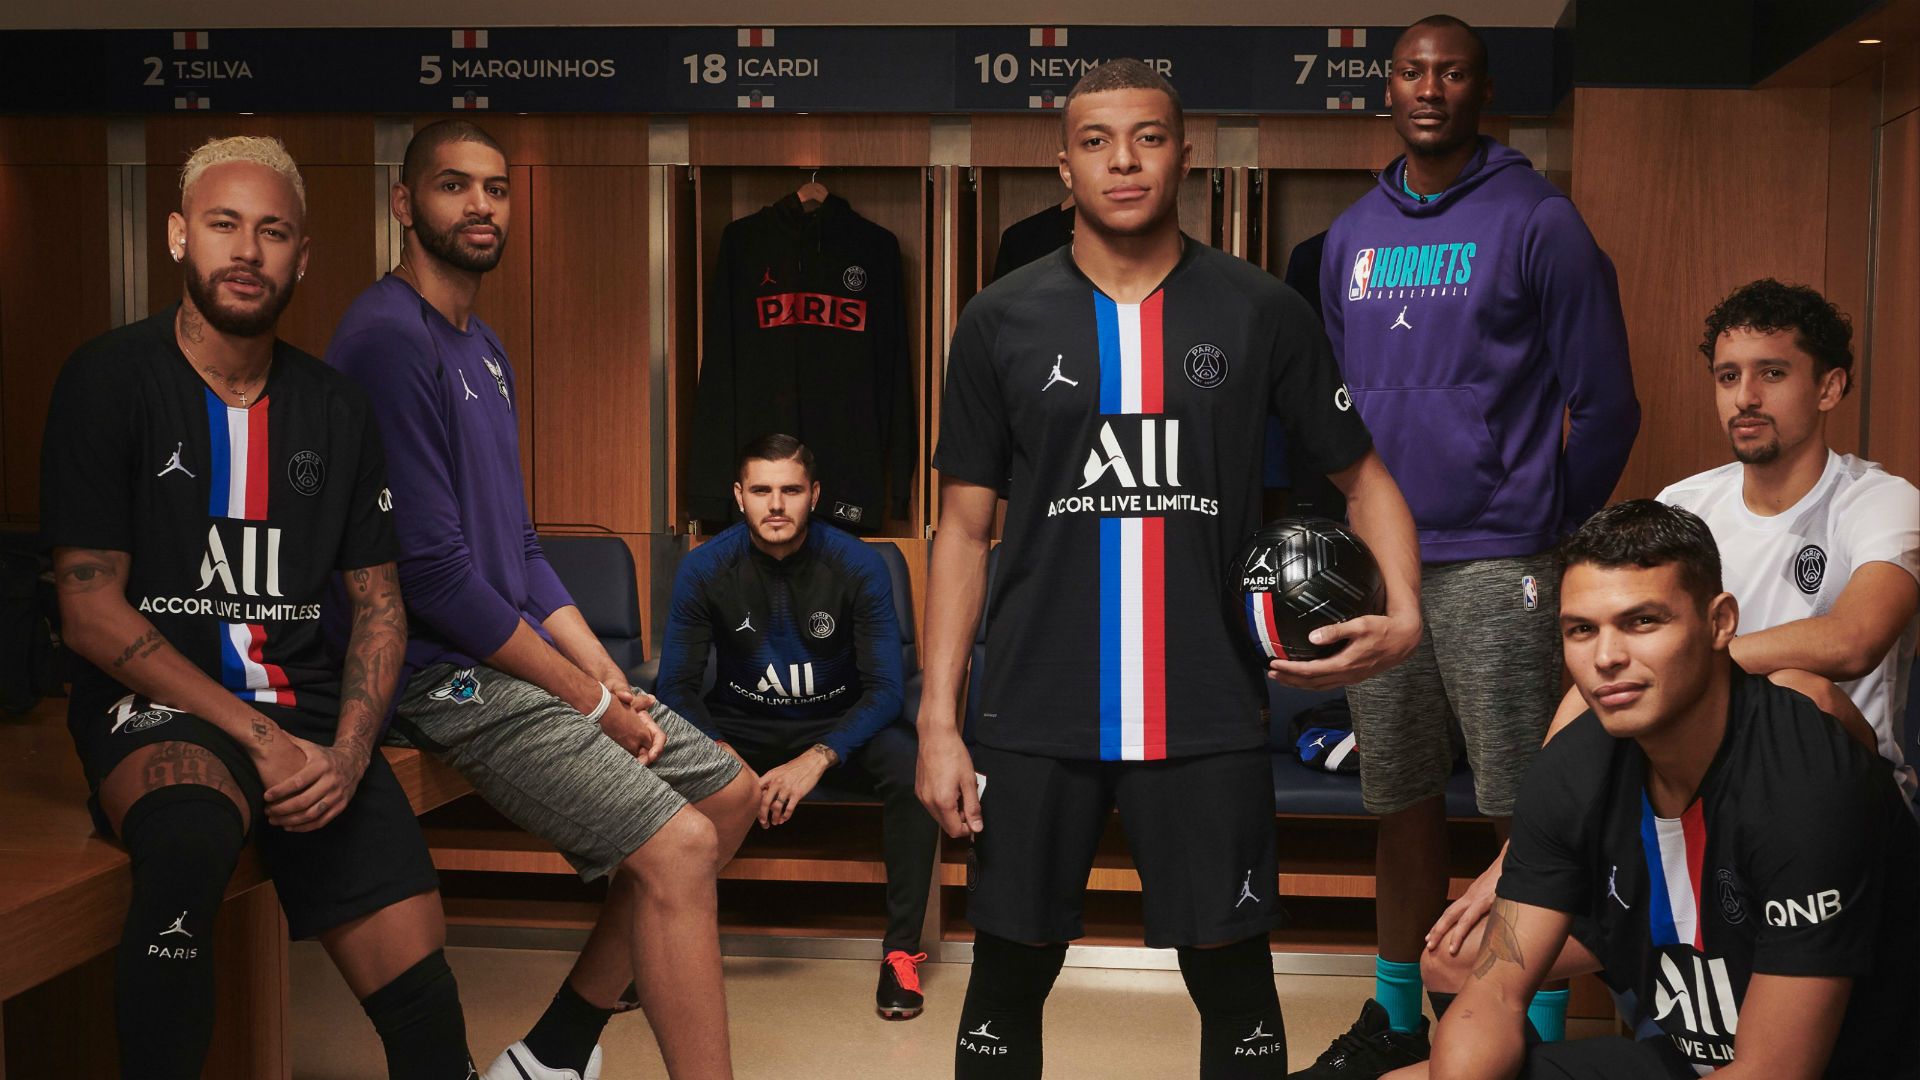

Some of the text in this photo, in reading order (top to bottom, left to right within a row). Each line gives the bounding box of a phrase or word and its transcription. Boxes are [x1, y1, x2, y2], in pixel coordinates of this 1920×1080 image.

[143, 57, 254, 86] 2 T.SILVA
[419, 55, 616, 86] 5 MARQUINHOS
[683, 53, 819, 84] 18 ICARDI
[974, 52, 1019, 84] 10
[1030, 57, 1112, 77] NEYM
[1294, 54, 1393, 85] 7 MBAP
[1369, 242, 1477, 288] HORNETS
[1191, 346, 1221, 358] PARIS
[1100, 495, 1142, 512] LIVE
[1146, 494, 1219, 516] LIMITLES
[1243, 576, 1276, 587] PARIS
[138, 596, 321, 621] ACCOR LIVE LIMITLESS
[767, 697, 793, 706] LIVE
[1765, 888, 1842, 928] QNB
[147, 944, 199, 960] PARIS
[960, 1037, 1008, 1056] PARIS
[1234, 1042, 1281, 1057] PARIS
[1671, 1033, 1708, 1059] LIVE
